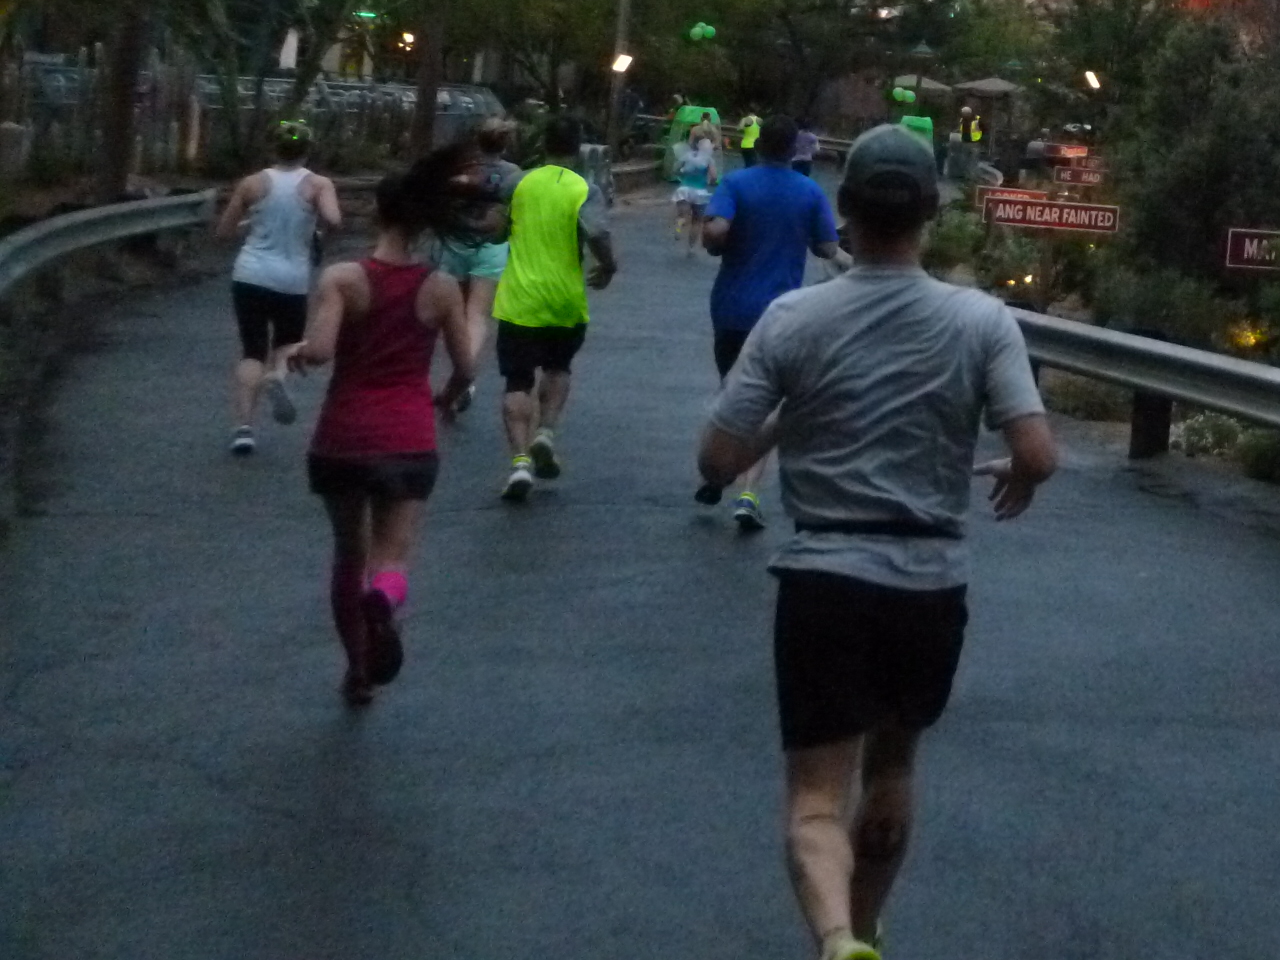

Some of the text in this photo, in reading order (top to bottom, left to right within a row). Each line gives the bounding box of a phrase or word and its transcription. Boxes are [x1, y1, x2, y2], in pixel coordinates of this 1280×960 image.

[1060, 170, 1100, 183] HE HAD
[988, 202, 1114, 227] ANG NEAR FAINTED
